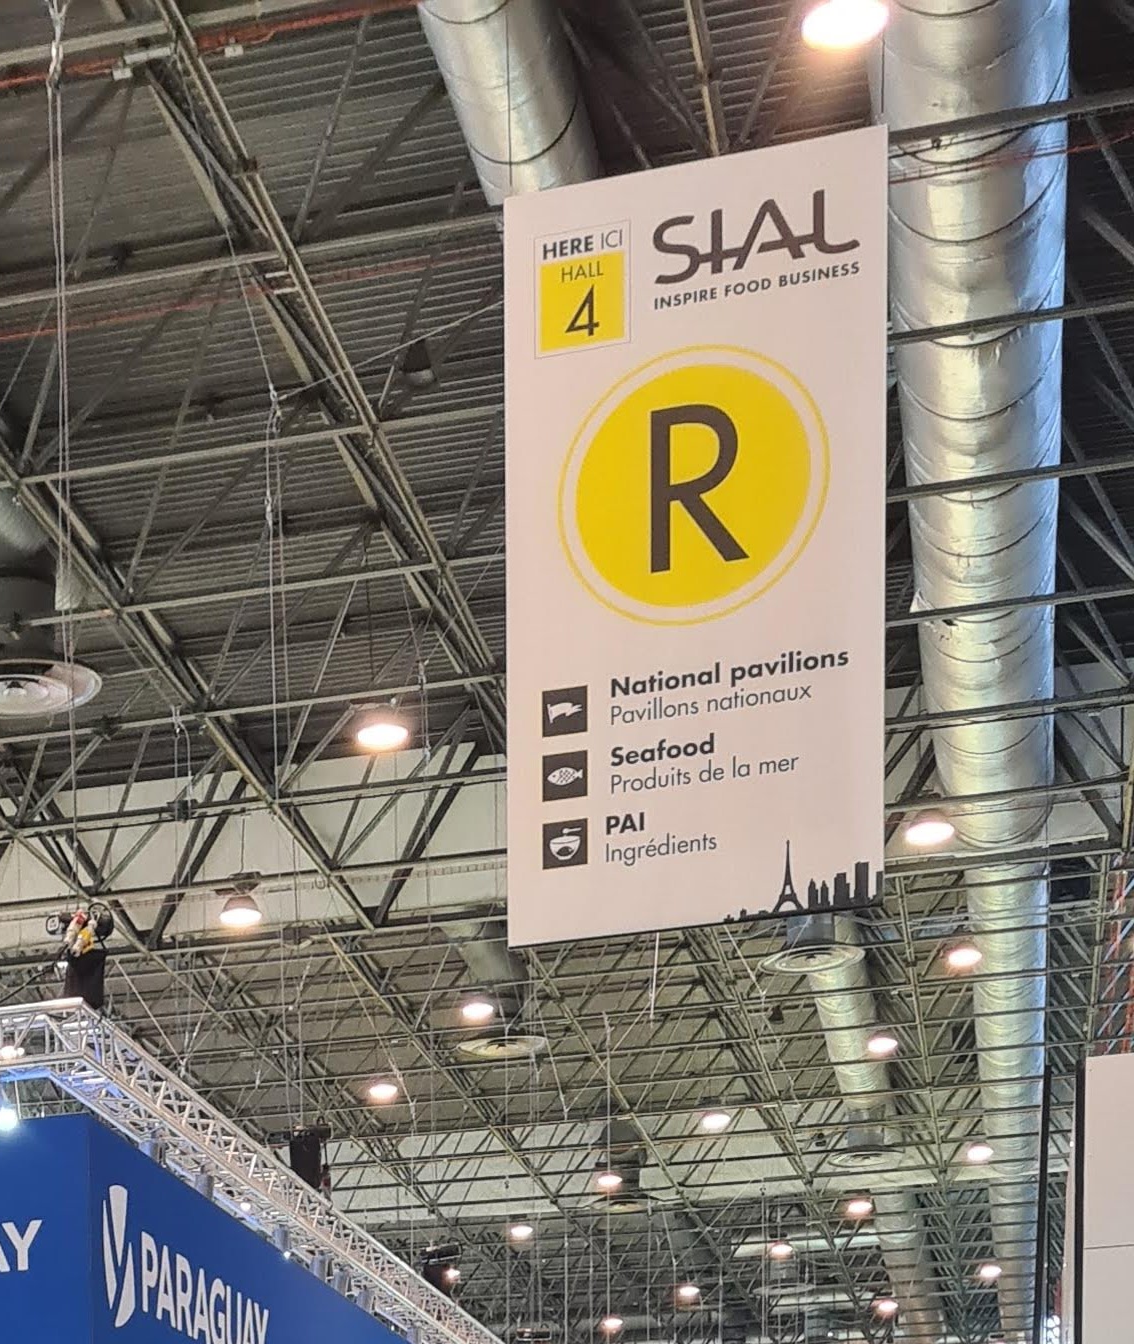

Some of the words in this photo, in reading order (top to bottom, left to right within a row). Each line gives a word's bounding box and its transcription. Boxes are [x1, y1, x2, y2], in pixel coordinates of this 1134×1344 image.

[542, 235, 594, 260] HERE
[601, 229, 624, 249] ICI
[652, 189, 860, 284] SIAL
[561, 262, 604, 283] HALL
[654, 287, 717, 310] INSPIRE
[724, 278, 771, 297] FOOD
[778, 261, 860, 288] BUSINESS
[564, 284, 600, 337] 4
[649, 404, 748, 574] R
[610, 661, 721, 698] National
[730, 650, 850, 688] pavilions
[610, 697, 699, 725] Pavillons
[707, 685, 813, 713] nationaux
[610, 732, 715, 766] Seafood
[610, 766, 691, 794] Produits
[698, 759, 726, 783] de
[732, 756, 751, 778] la
[759, 755, 799, 775] mer
[605, 812, 645, 835] PAI
[605, 832, 717, 867] Ingrédients
